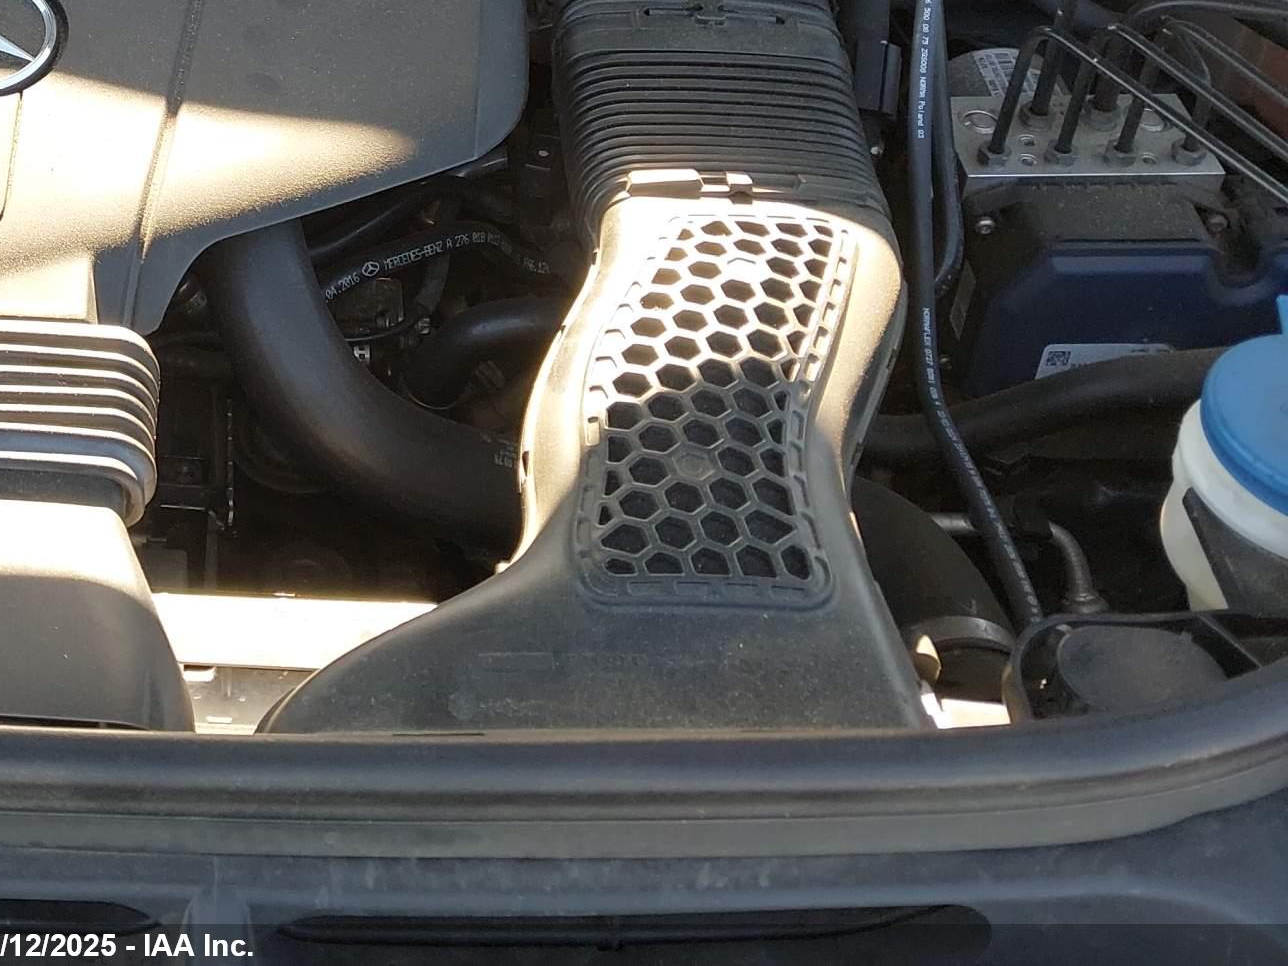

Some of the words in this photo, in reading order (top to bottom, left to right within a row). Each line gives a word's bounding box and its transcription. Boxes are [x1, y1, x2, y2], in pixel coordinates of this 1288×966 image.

[917, 100, 926, 127] Poland
[383, 240, 443, 271] MERCEDES-BENZ
[446, 239, 453, 250] A
